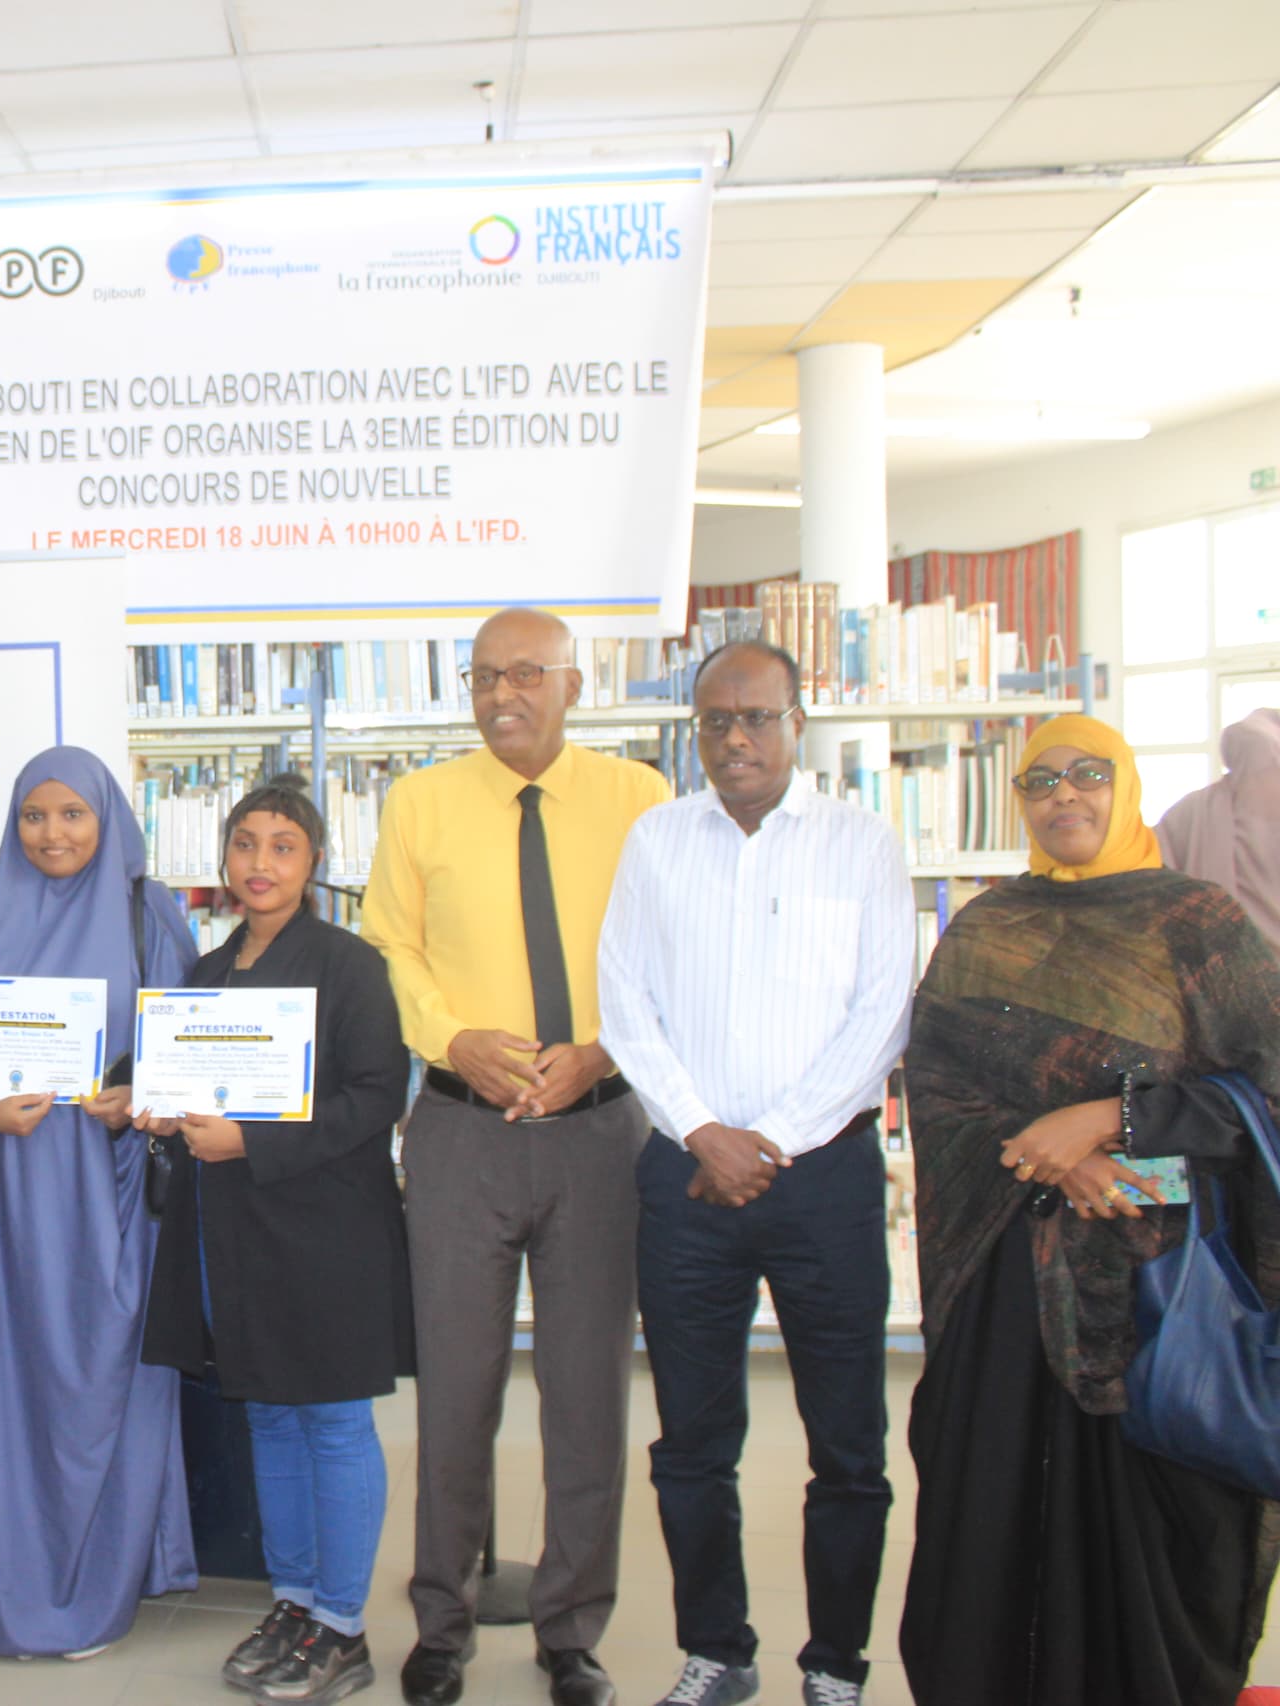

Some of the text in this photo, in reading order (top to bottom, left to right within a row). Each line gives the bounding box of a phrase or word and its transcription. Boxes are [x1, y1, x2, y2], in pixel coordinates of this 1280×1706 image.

[536, 202, 666, 236] INSTITUT
[228, 244, 274, 256] Presse
[227, 261, 321, 279] francophone
[338, 267, 522, 293] la francophonie
[93, 287, 146, 302] Djibouti
[82, 379, 118, 413] EN
[129, 369, 368, 407] COLLABORATION
[376, 366, 451, 401] AVEC
[462, 364, 530, 400] L'IFD
[547, 361, 623, 396] AVEC
[634, 360, 668, 395] LE
[41, 429, 76, 462] DE
[87, 425, 152, 461] L'OIF
[164, 420, 312, 457] ORGANISE
[323, 419, 356, 453] LA
[365, 416, 441, 450] 3EME
[452, 409, 568, 448] ÉDITION
[580, 412, 619, 445] DU
[78, 465, 450, 509] CONCOURS DE NOUVELLE
[216, 526, 242, 547] 18
[251, 524, 308, 547] JUIN
[318, 518, 335, 544] À
[345, 521, 420, 544] 10H00
[429, 515, 447, 542] À
[456, 519, 526, 542] L'IFD.
[183, 1024, 263, 1034] ATTESTATION
